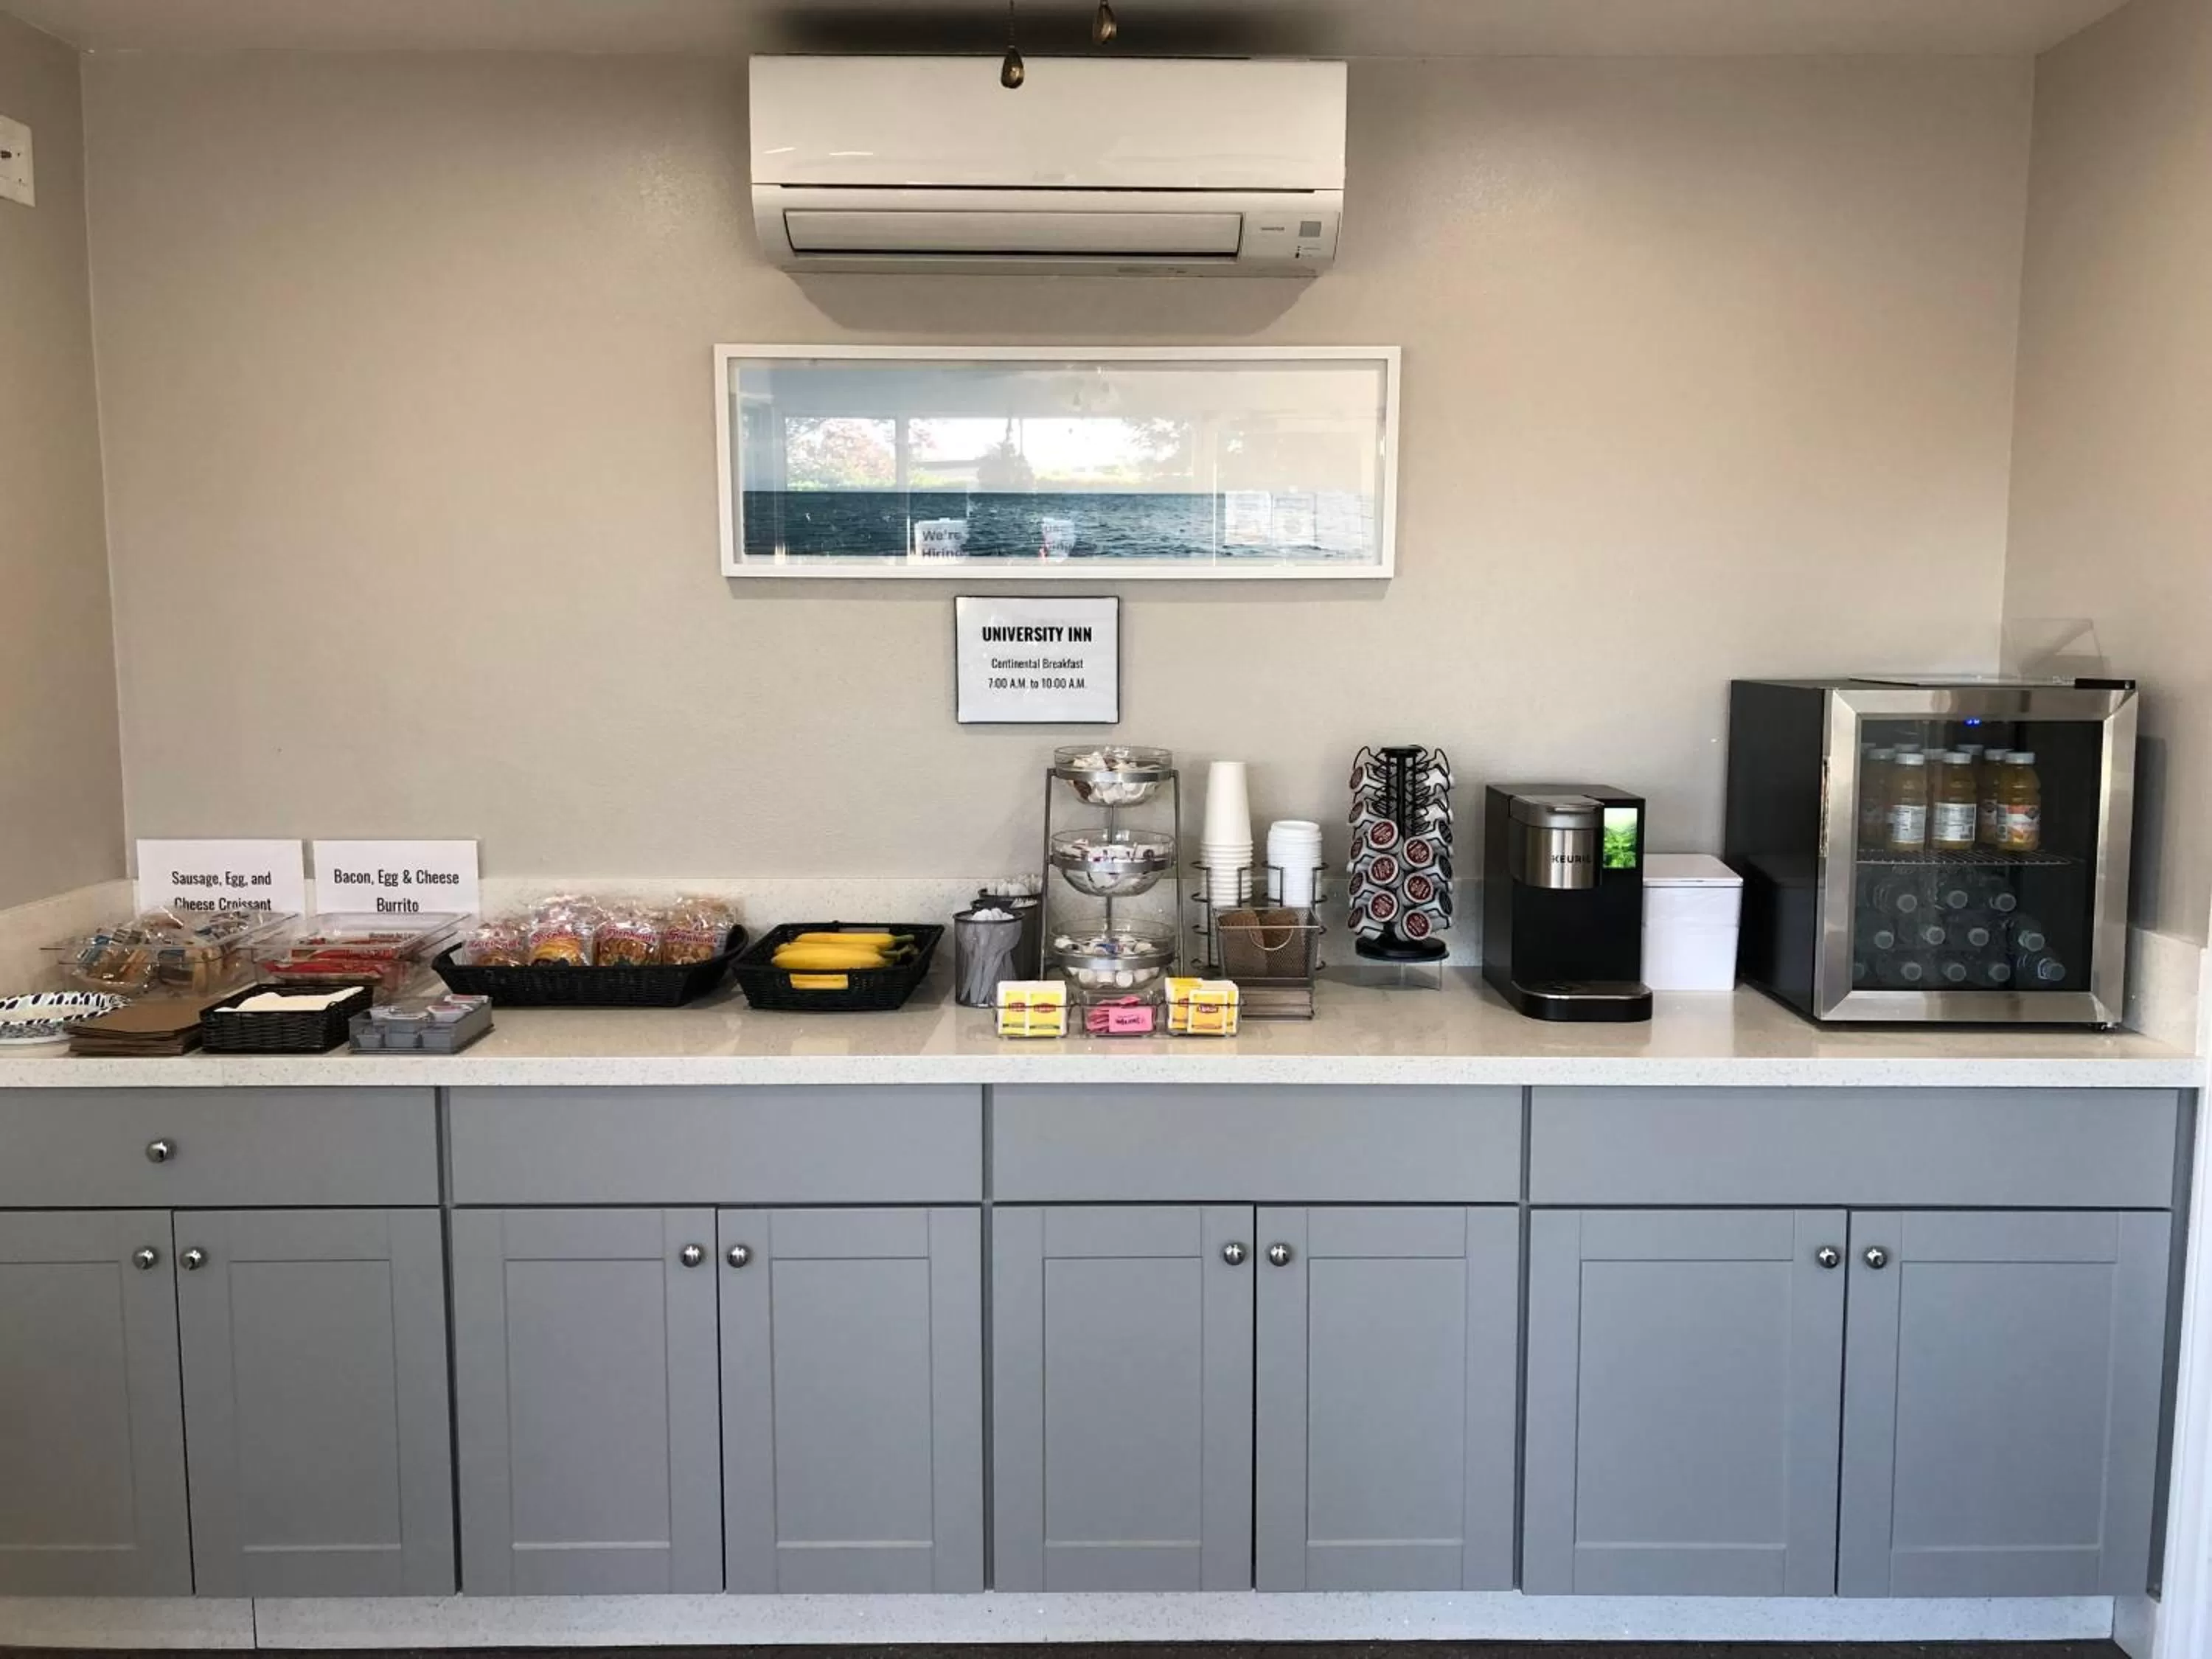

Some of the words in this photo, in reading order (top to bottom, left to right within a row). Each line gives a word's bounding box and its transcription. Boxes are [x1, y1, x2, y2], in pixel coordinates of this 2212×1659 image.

[922, 529, 961, 541] We're
[982, 627, 1063, 642] UNIVERSITY
[1068, 627, 1092, 642] INN
[991, 658, 1040, 669] Continental
[1042, 658, 1083, 669] Breakfast
[1030, 678, 1039, 689] to
[172, 871, 222, 888] Sausage,
[225, 871, 248, 888] Egg,
[251, 871, 271, 886] and
[334, 869, 375, 886] Bacon,
[378, 869, 399, 887] Egg
[403, 869, 412, 884] &
[416, 869, 459, 885] Cheese
[174, 897, 215, 911] Cheese
[218, 897, 271, 911] Croissant
[377, 897, 420, 912] Burrito
